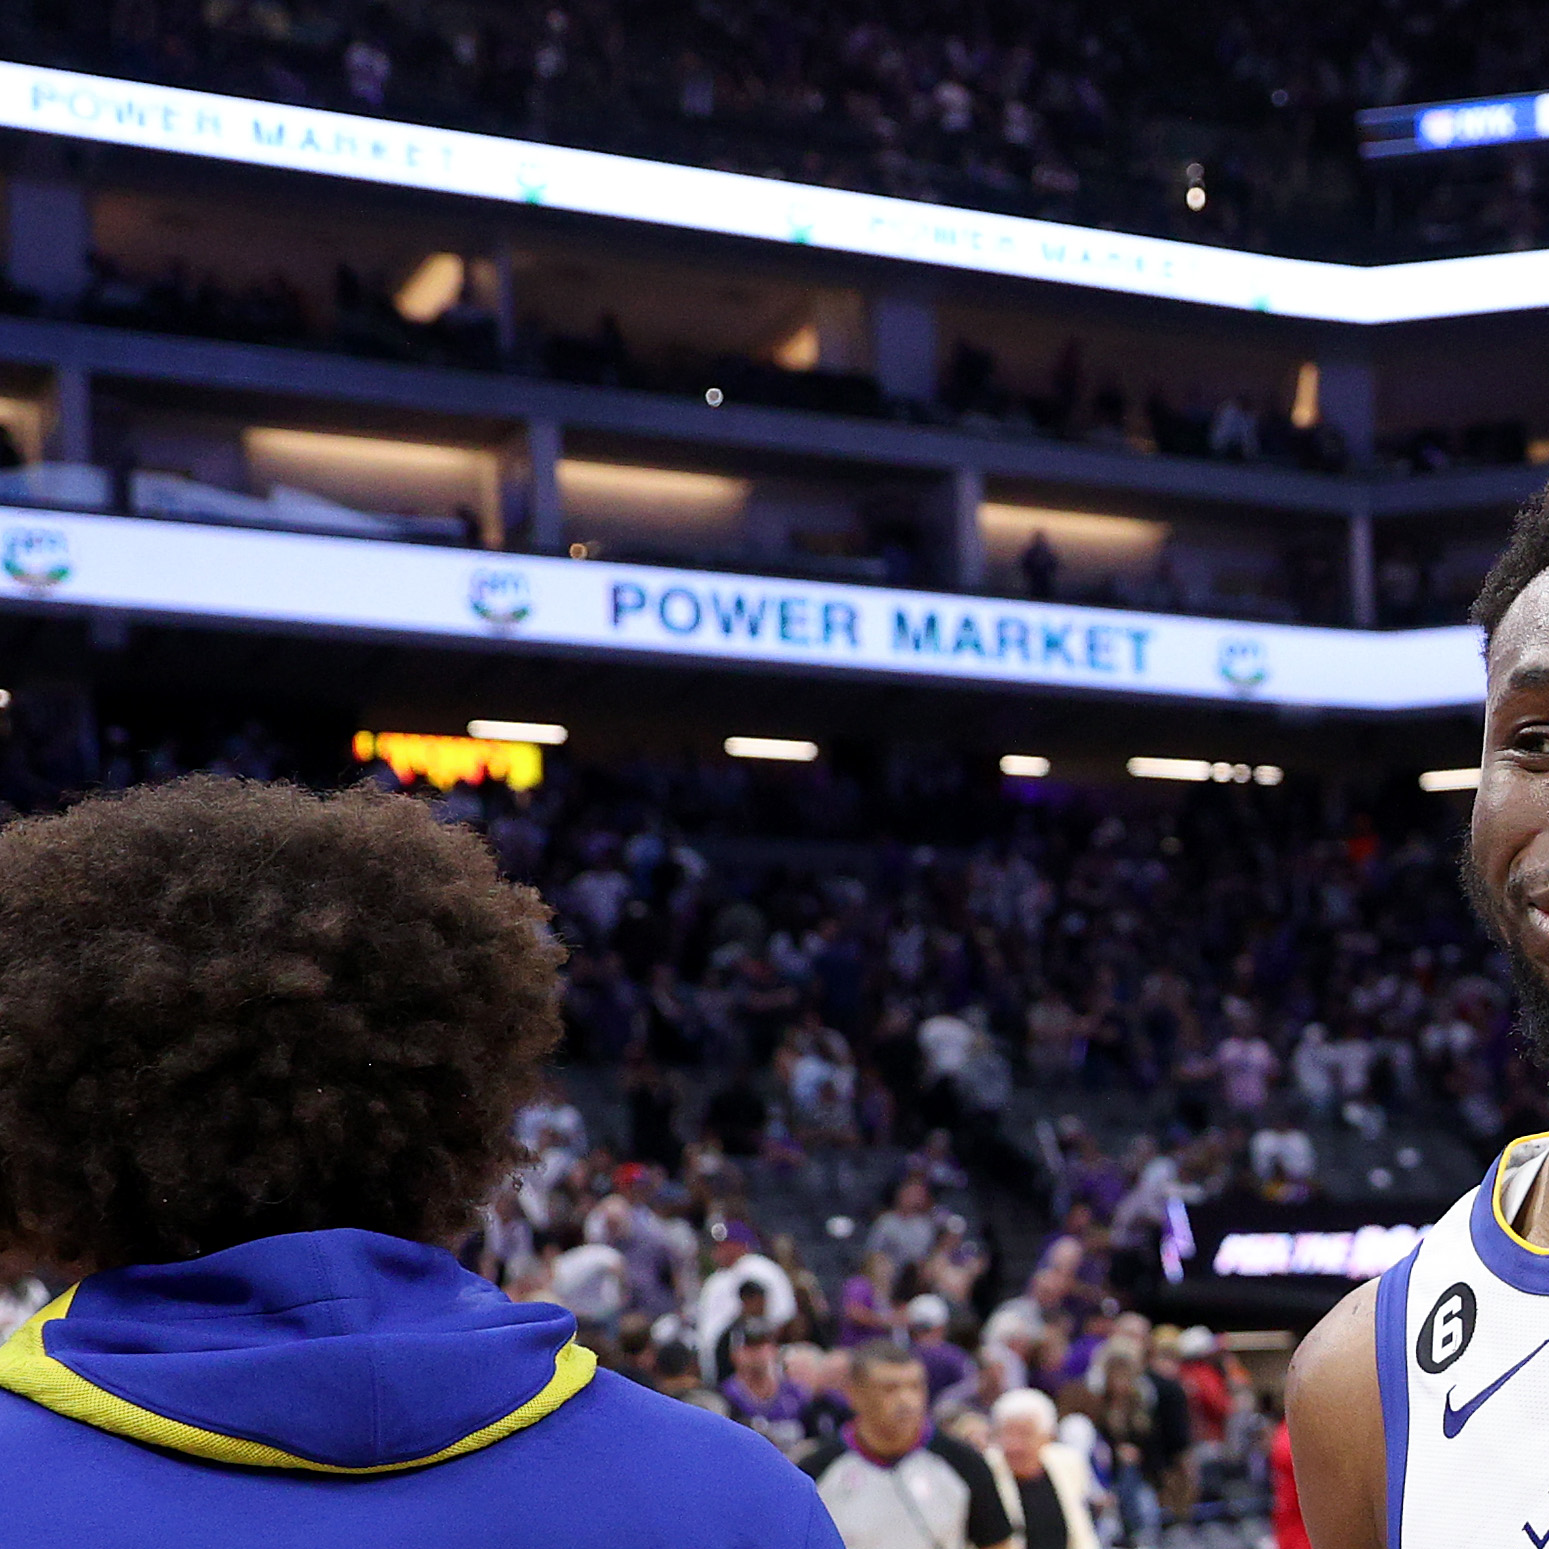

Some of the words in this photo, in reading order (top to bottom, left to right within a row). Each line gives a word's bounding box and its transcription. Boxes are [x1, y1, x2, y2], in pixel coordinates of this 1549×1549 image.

[28, 80, 224, 136] POWER
[611, 581, 858, 647] POWER
[893, 609, 1153, 675] MARKET
[1430, 1301, 1463, 1363] 6
